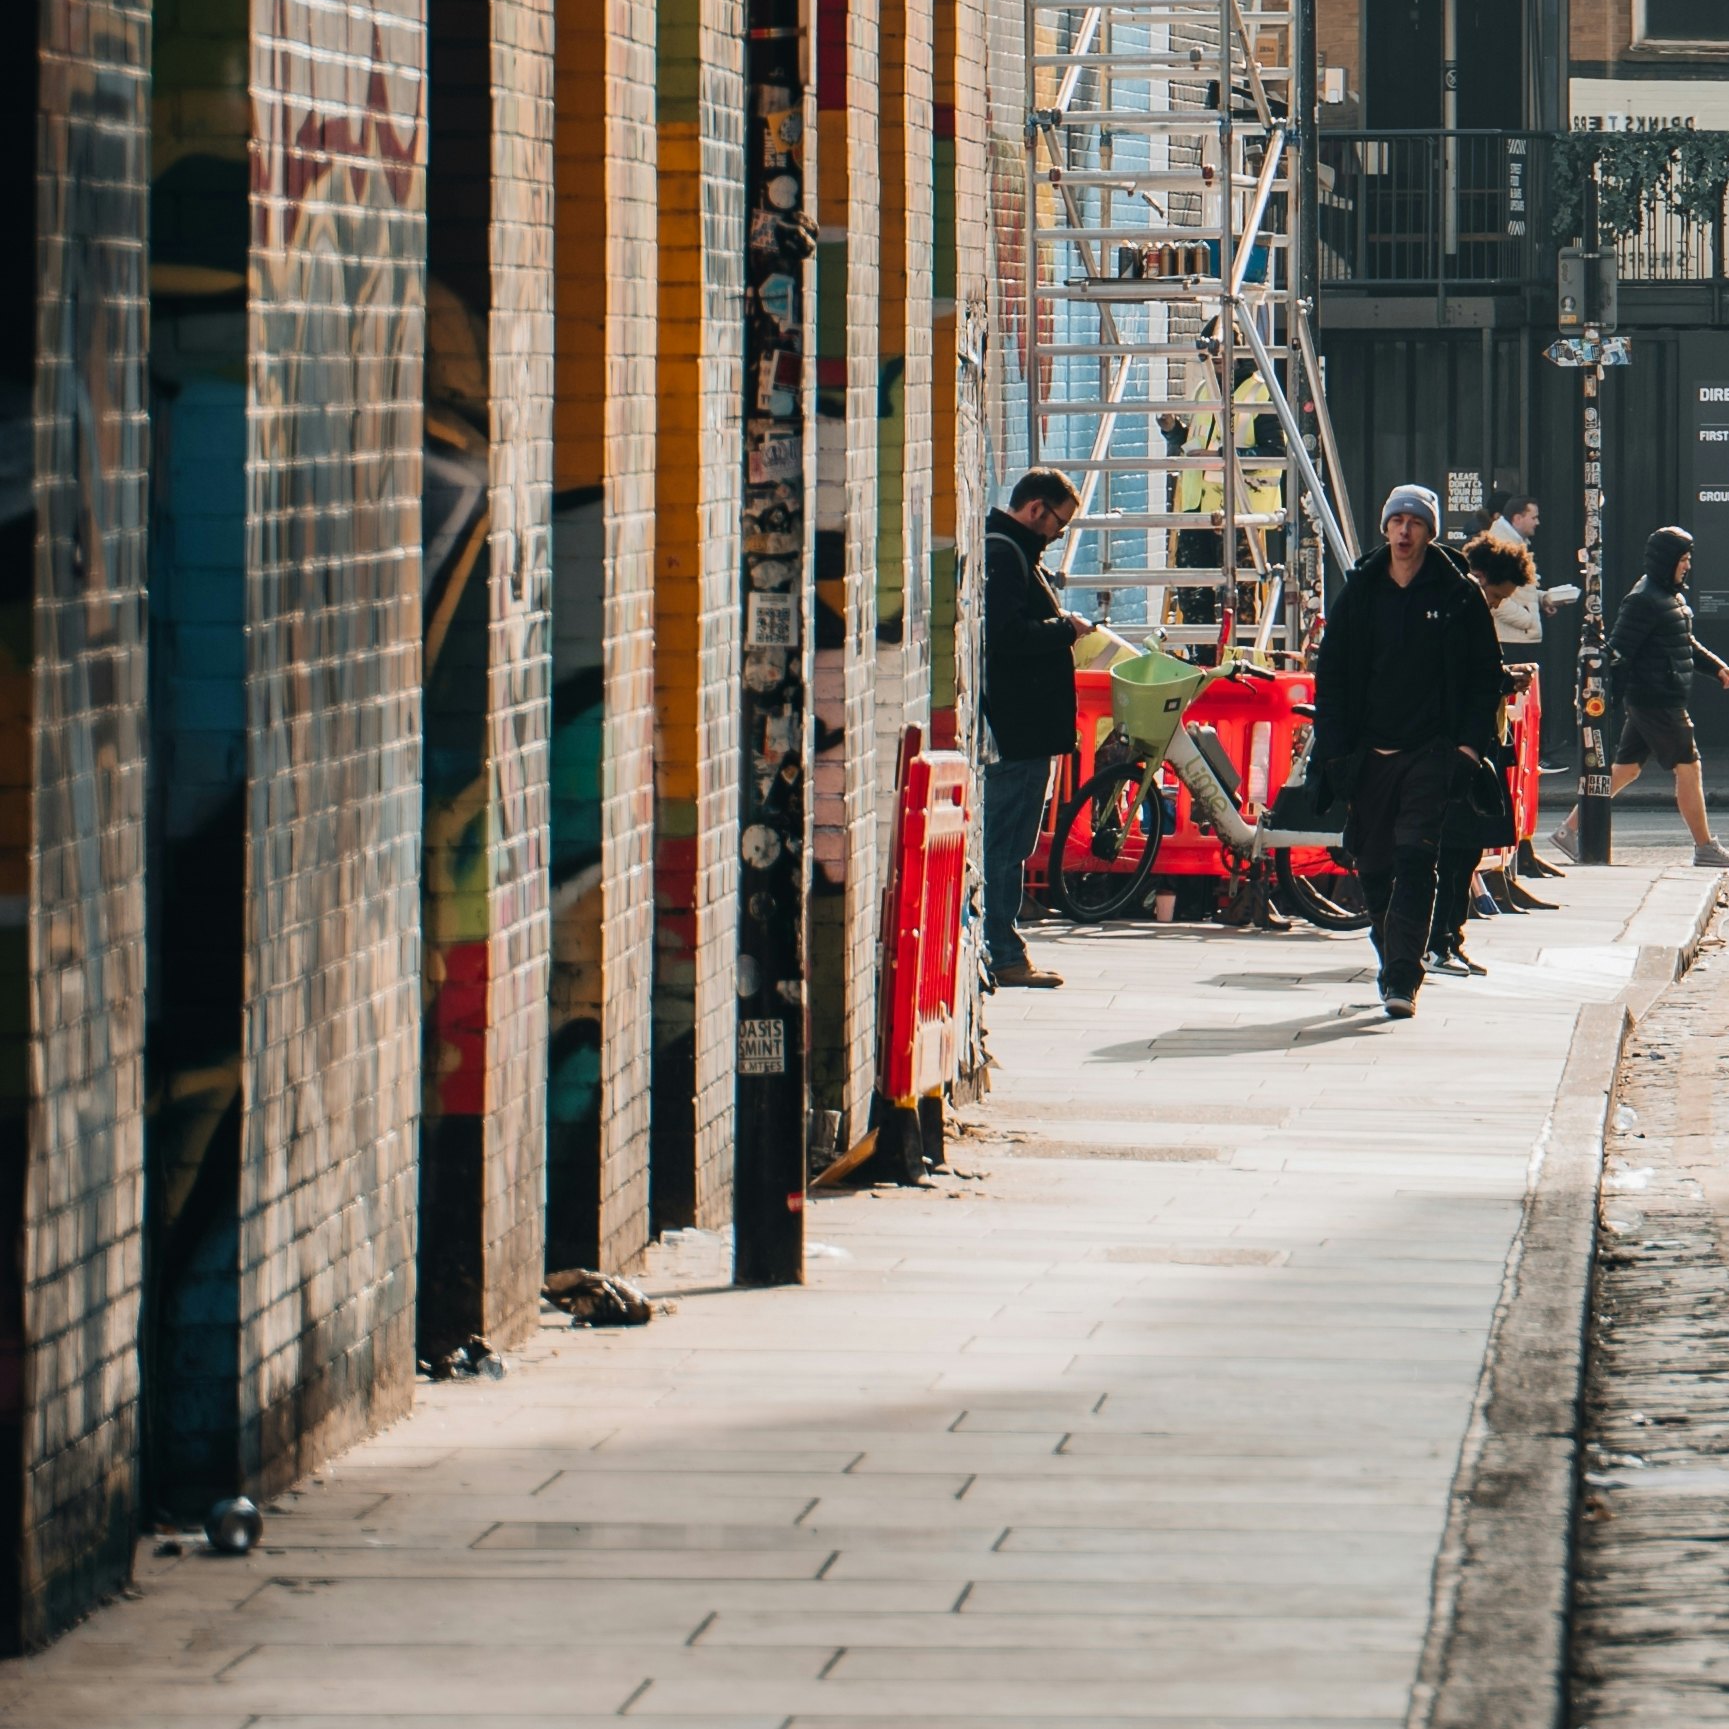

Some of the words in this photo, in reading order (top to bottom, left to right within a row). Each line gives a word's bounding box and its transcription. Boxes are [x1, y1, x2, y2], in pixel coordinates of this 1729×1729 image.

[1699, 431, 1729, 441] FIRST
[1448, 472, 1479, 480] PLEASE
[1448, 488, 1471, 496] YOUR
